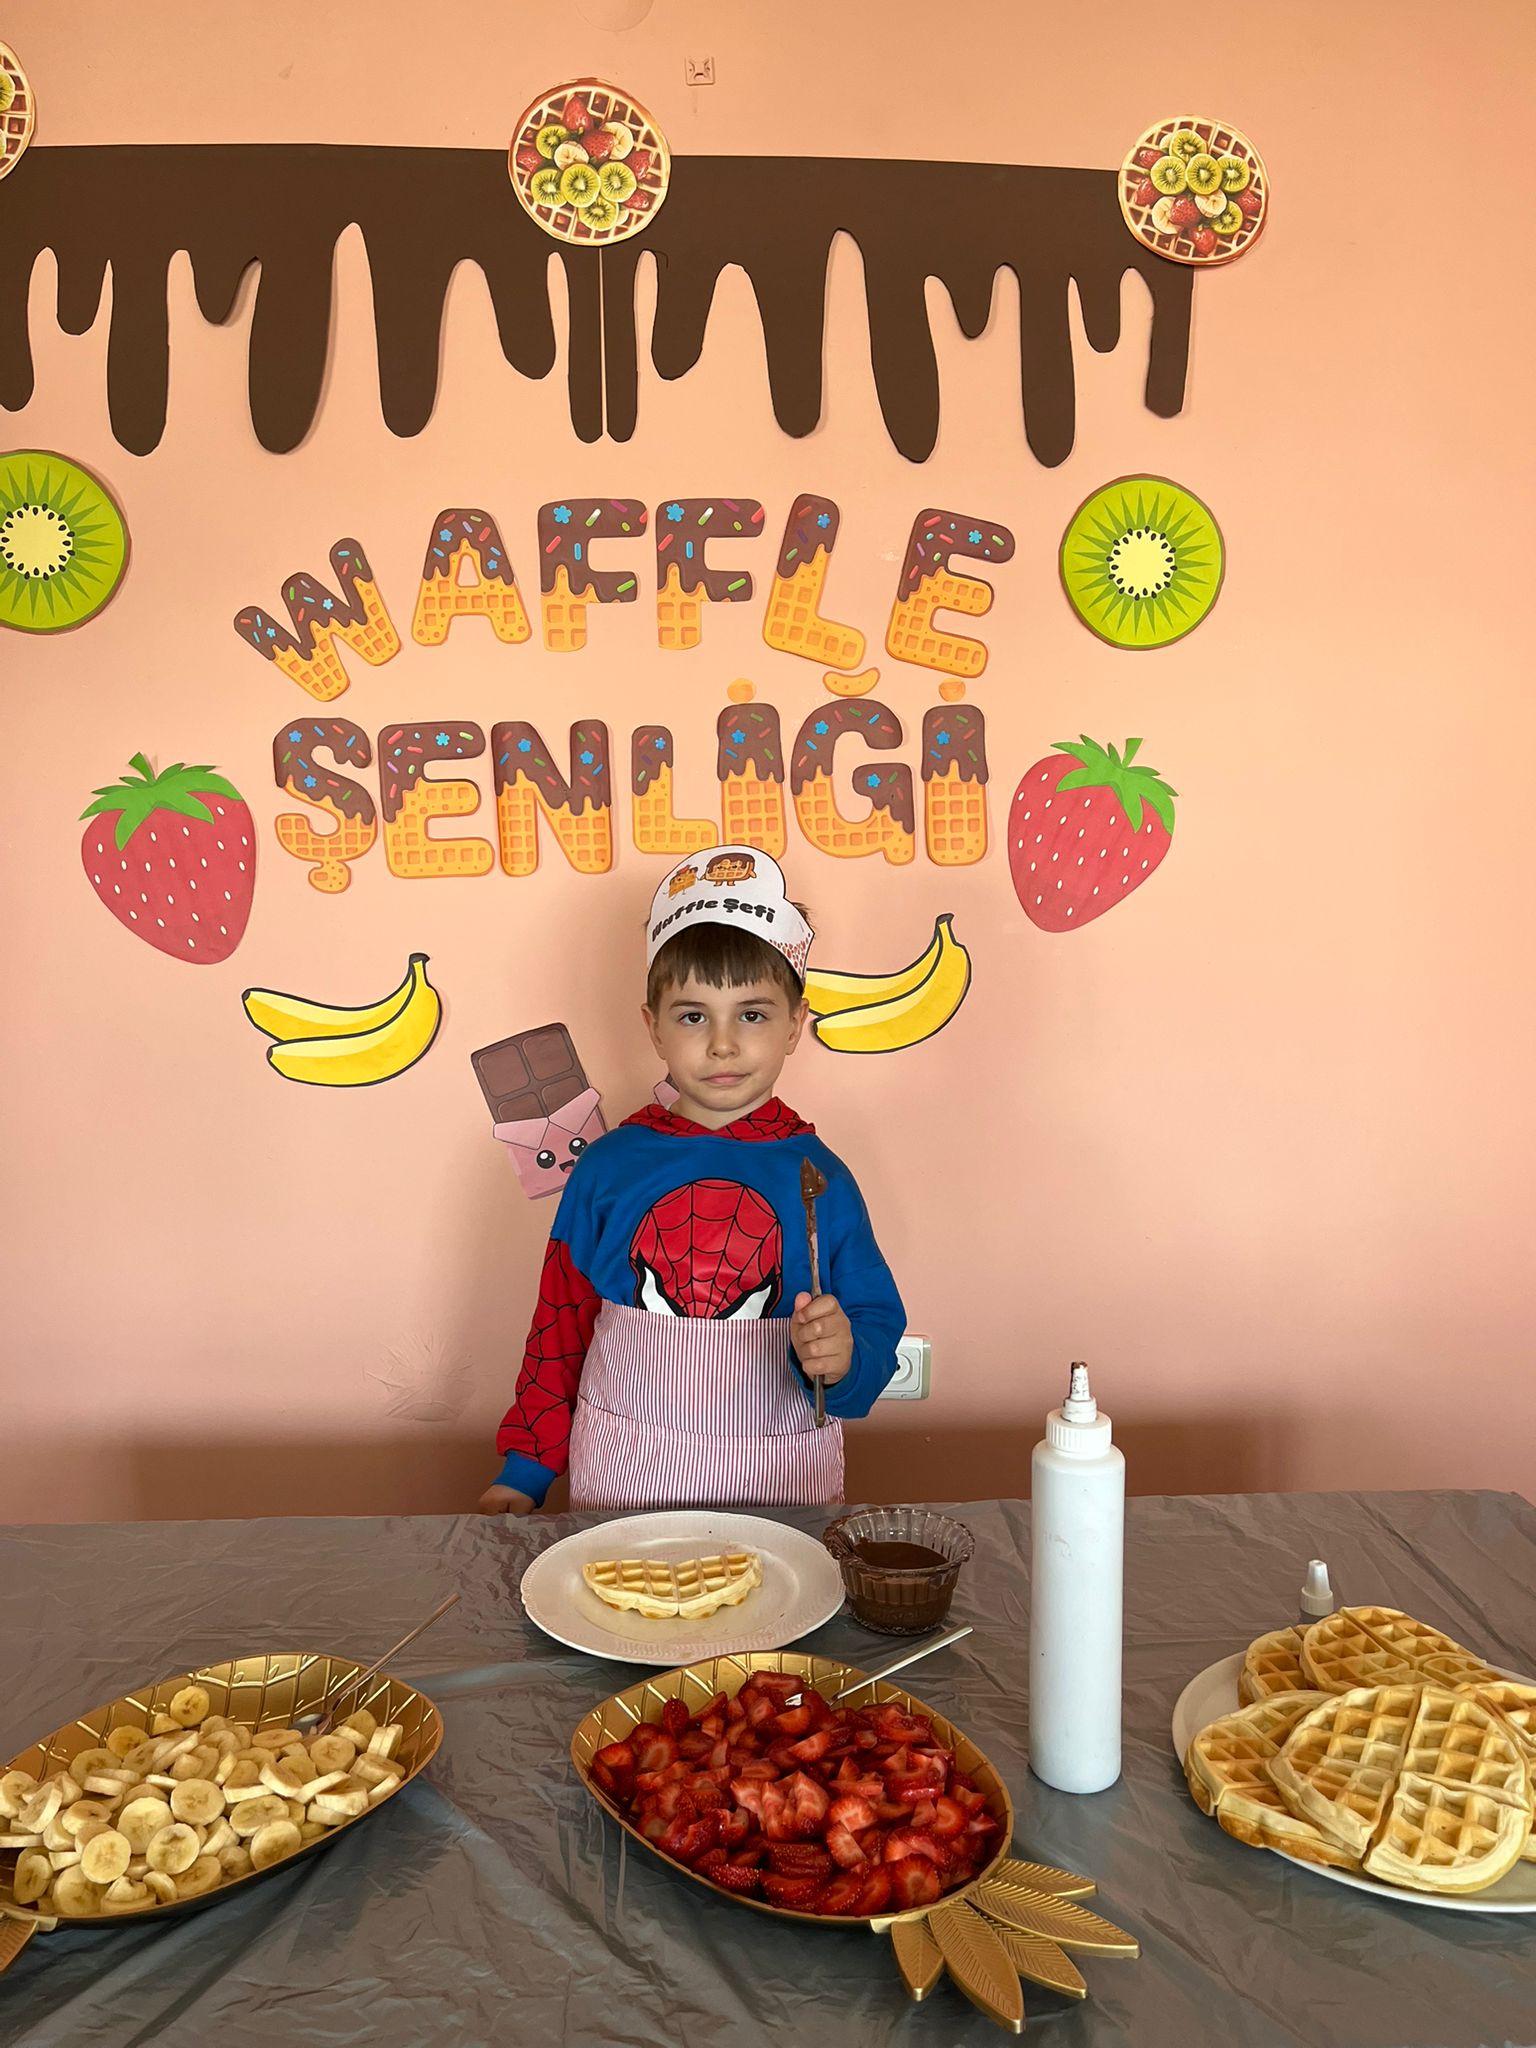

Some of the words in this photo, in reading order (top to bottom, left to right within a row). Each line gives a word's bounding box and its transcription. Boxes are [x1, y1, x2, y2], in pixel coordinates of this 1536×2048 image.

[233, 493, 1015, 702] WAFFLE
[273, 667, 988, 894] ŞENLİĞİ
[652, 899, 718, 942] Waffle
[722, 898, 776, 924] Şefi
